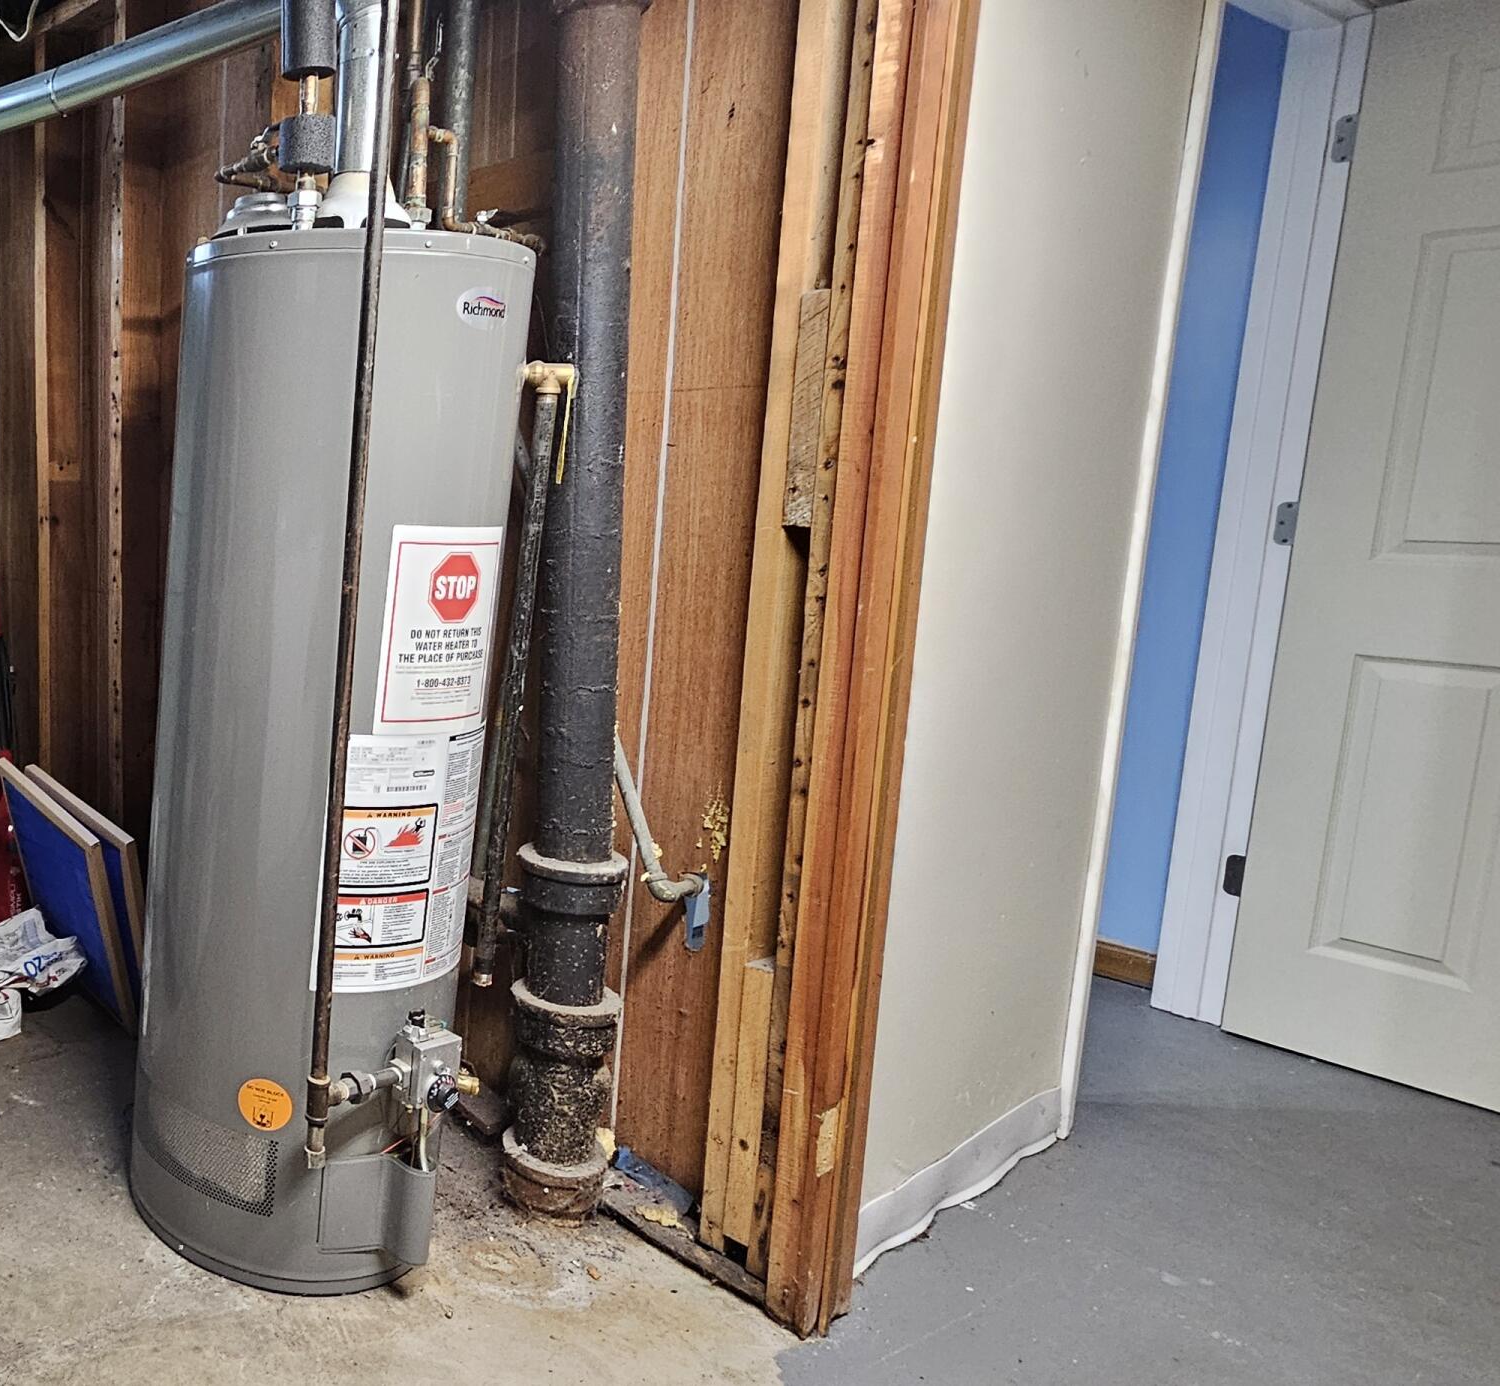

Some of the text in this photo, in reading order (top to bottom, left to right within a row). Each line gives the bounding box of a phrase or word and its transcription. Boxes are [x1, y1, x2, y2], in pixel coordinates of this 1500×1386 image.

[463, 301, 506, 319] Richmond
[434, 575, 477, 600] STOP
[410, 626, 482, 640] DO NOT RETURN THIS
[415, 638, 478, 651] WATER HEATER TO
[398, 648, 484, 664] THE PLACE OF PURCHASE
[376, 811, 412, 819] WARNING
[367, 896, 398, 905] DANGER
[364, 952, 395, 960] WARNING
